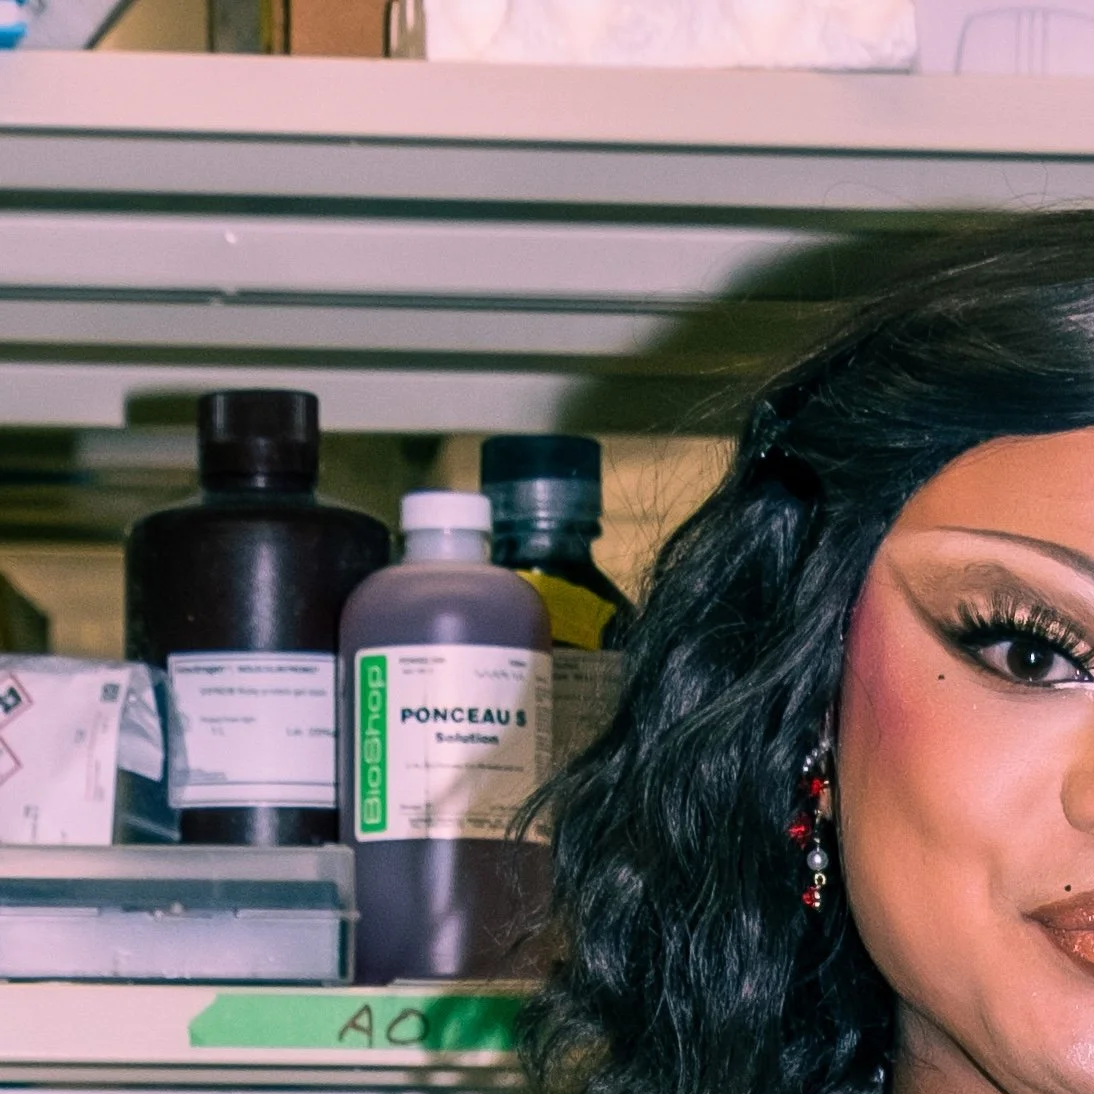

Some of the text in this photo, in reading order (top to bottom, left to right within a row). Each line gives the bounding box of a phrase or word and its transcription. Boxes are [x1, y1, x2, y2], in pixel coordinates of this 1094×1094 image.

[400, 707, 528, 727] PONCEAU S
[363, 665, 386, 825] BioShop
[435, 732, 499, 745] Solution
